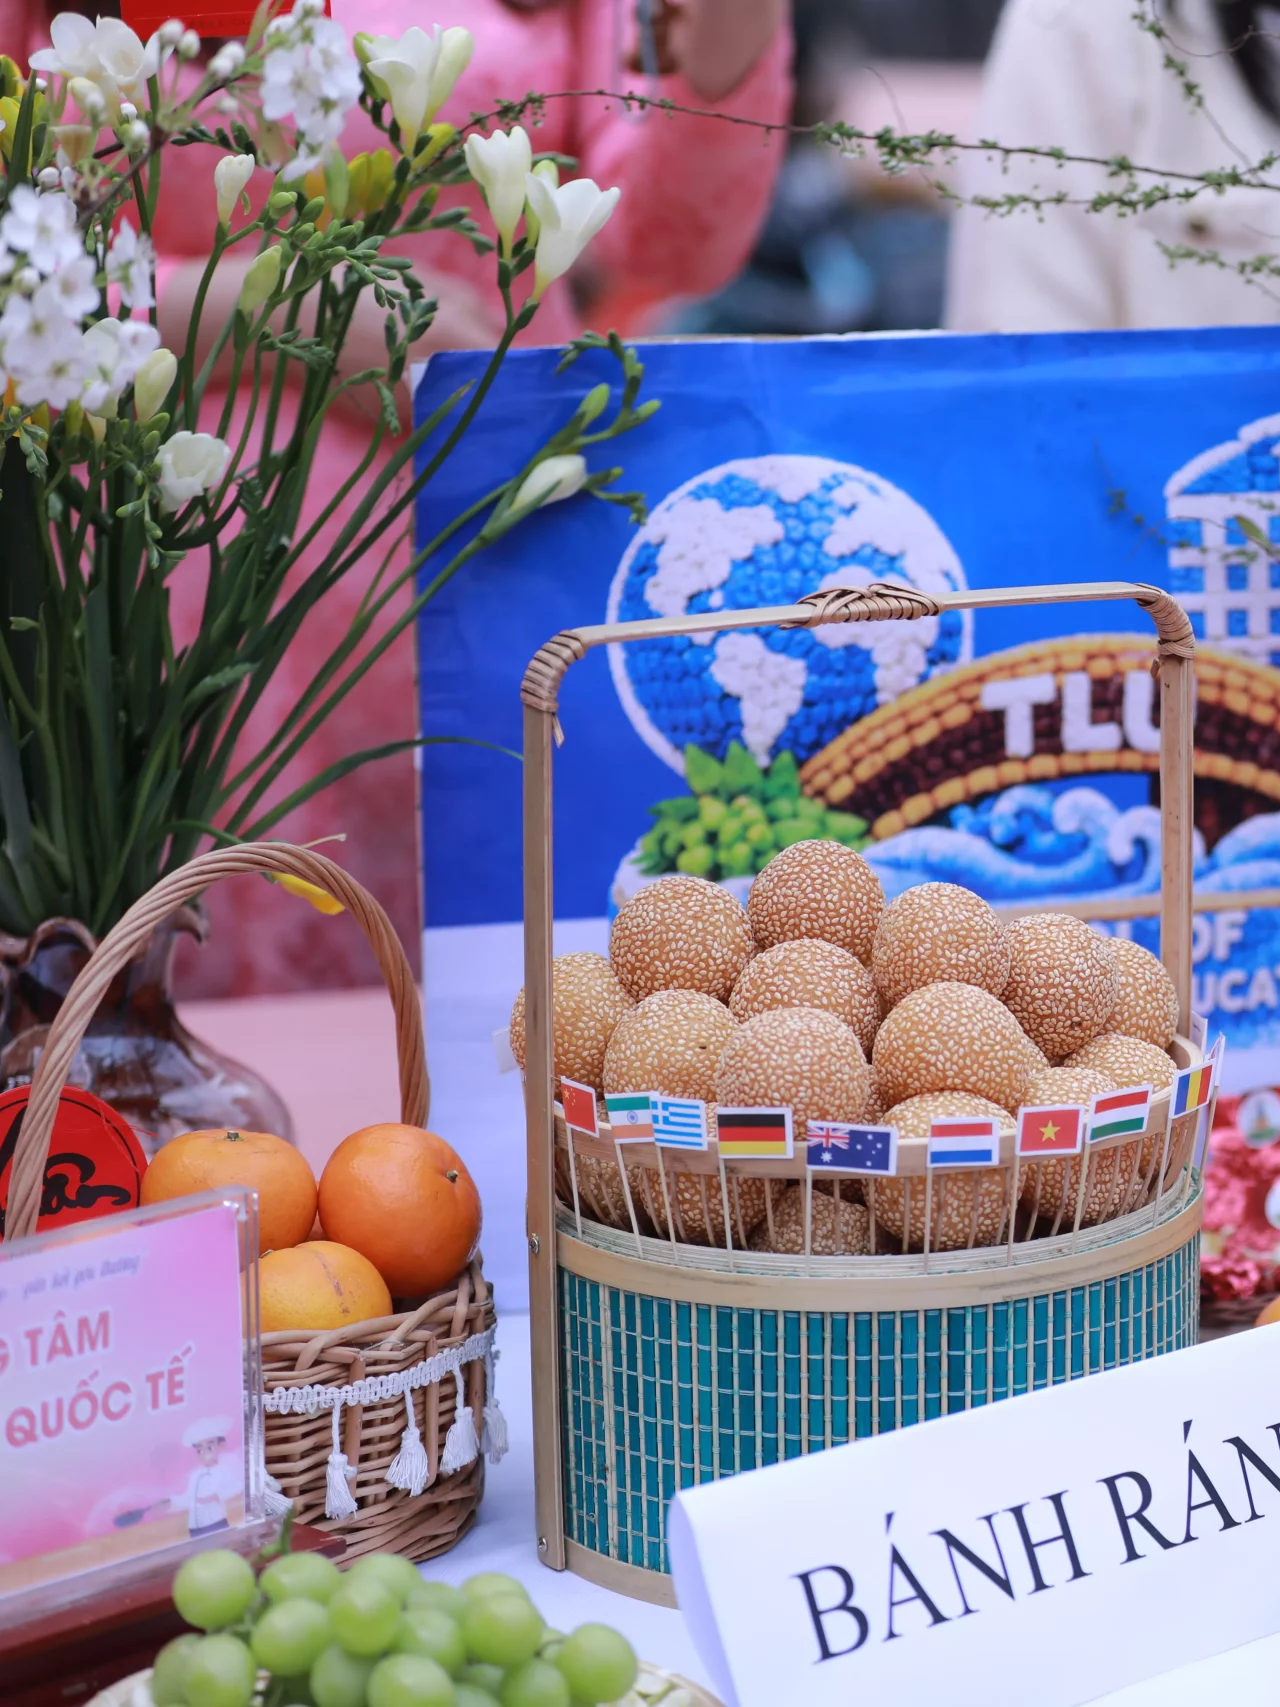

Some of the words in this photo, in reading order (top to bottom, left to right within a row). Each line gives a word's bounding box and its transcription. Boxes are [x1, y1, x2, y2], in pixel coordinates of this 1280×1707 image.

[24, 1310, 110, 1367] TÂM
[5, 1369, 132, 1448] QUỐC
[145, 1345, 192, 1410] TẾ
[790, 1511, 1093, 1663] BÁNH
